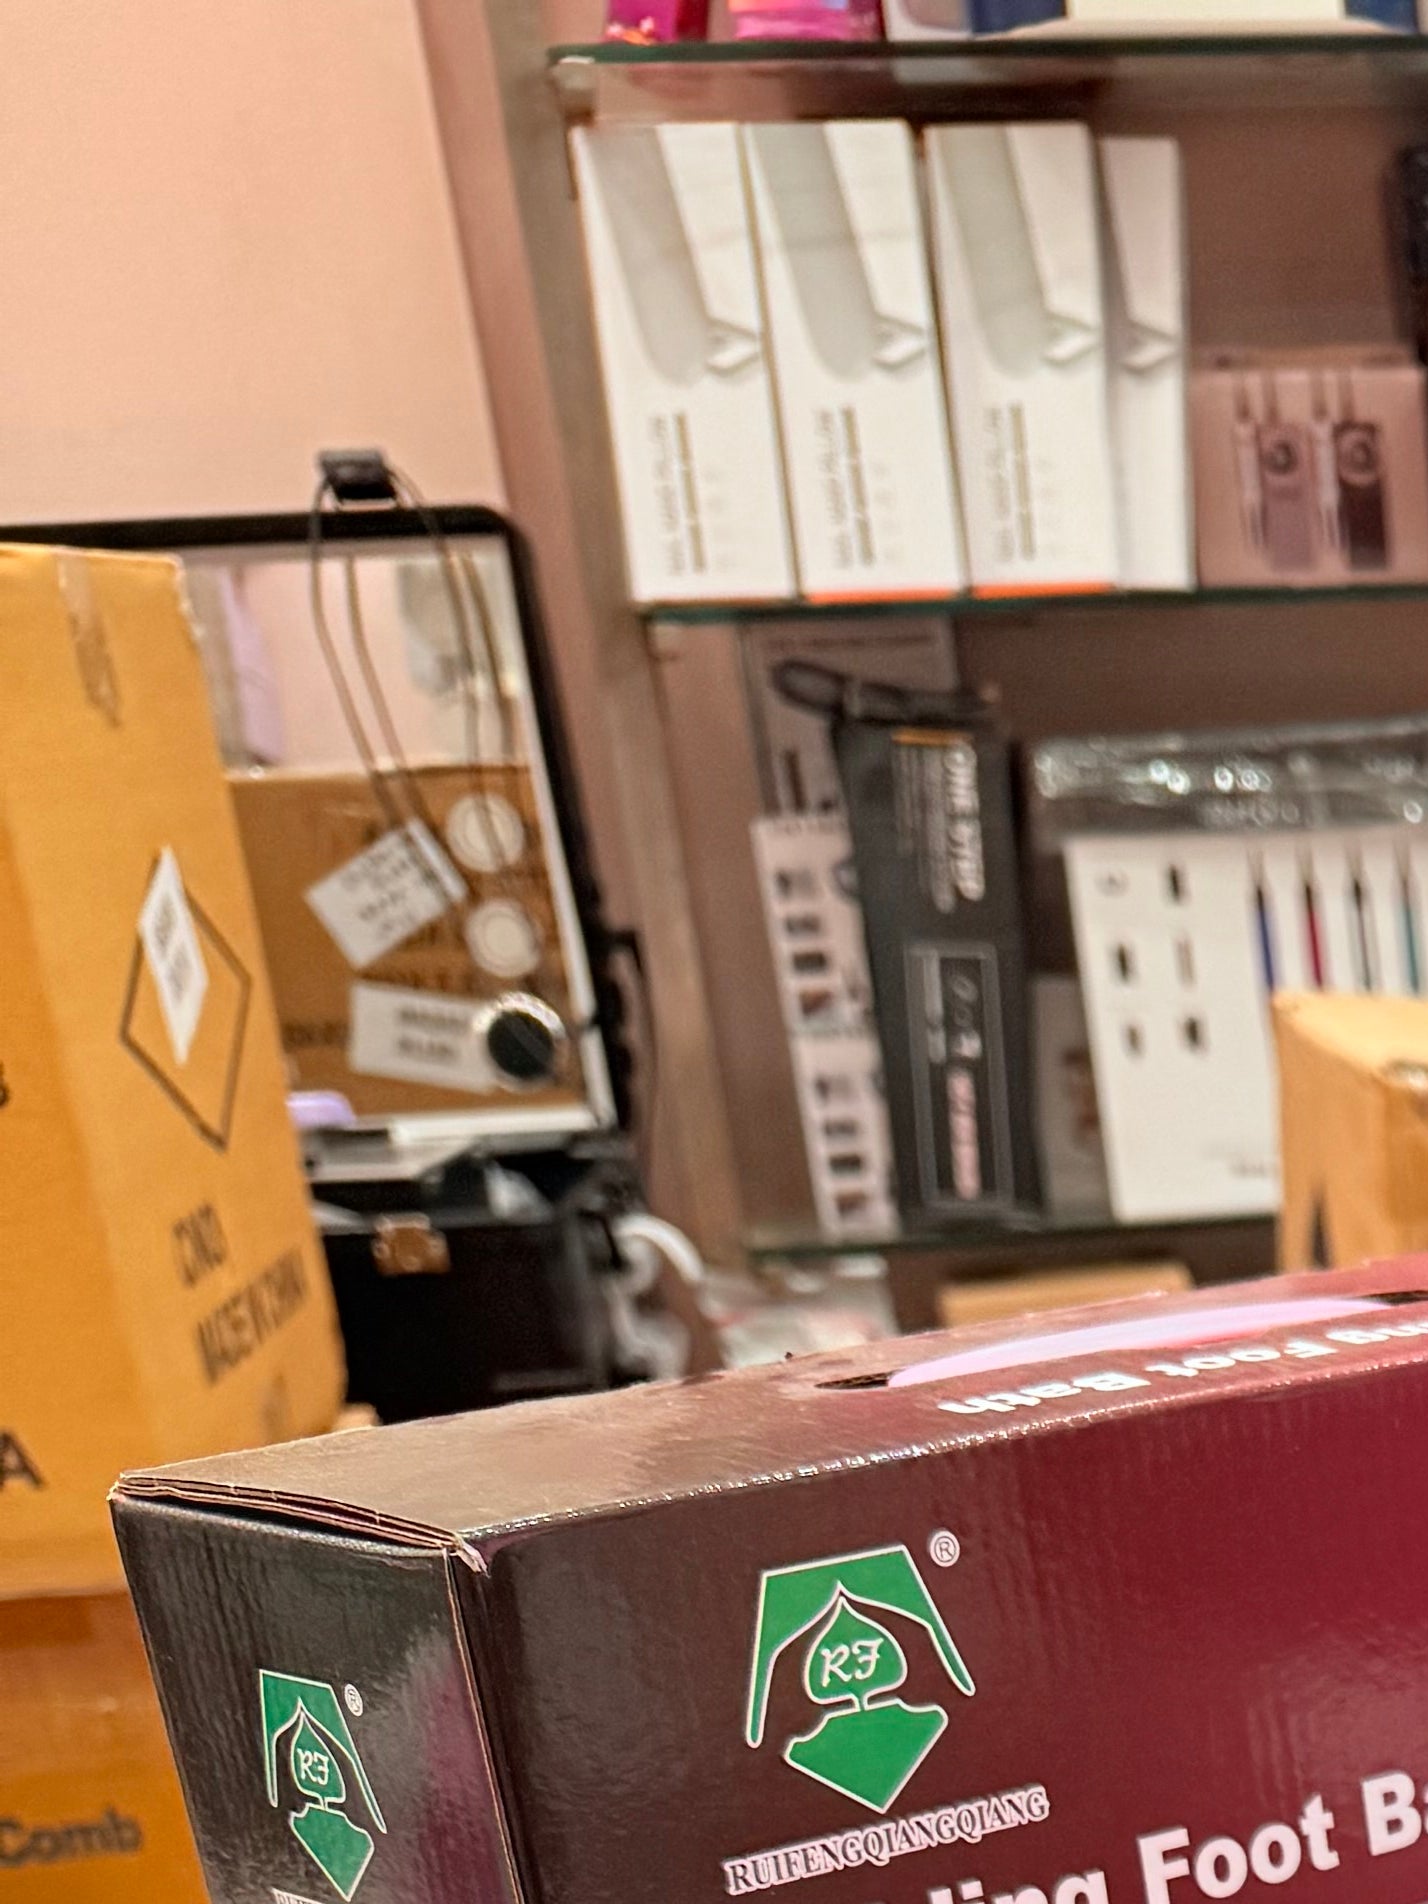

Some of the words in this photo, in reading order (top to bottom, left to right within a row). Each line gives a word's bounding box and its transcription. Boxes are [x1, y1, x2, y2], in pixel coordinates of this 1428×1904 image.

[1144, 1338, 1338, 1377] Foot
[937, 1371, 1151, 1414] Bath
[723, 1782, 1052, 1897] RUIFENGQIANGQIANG
